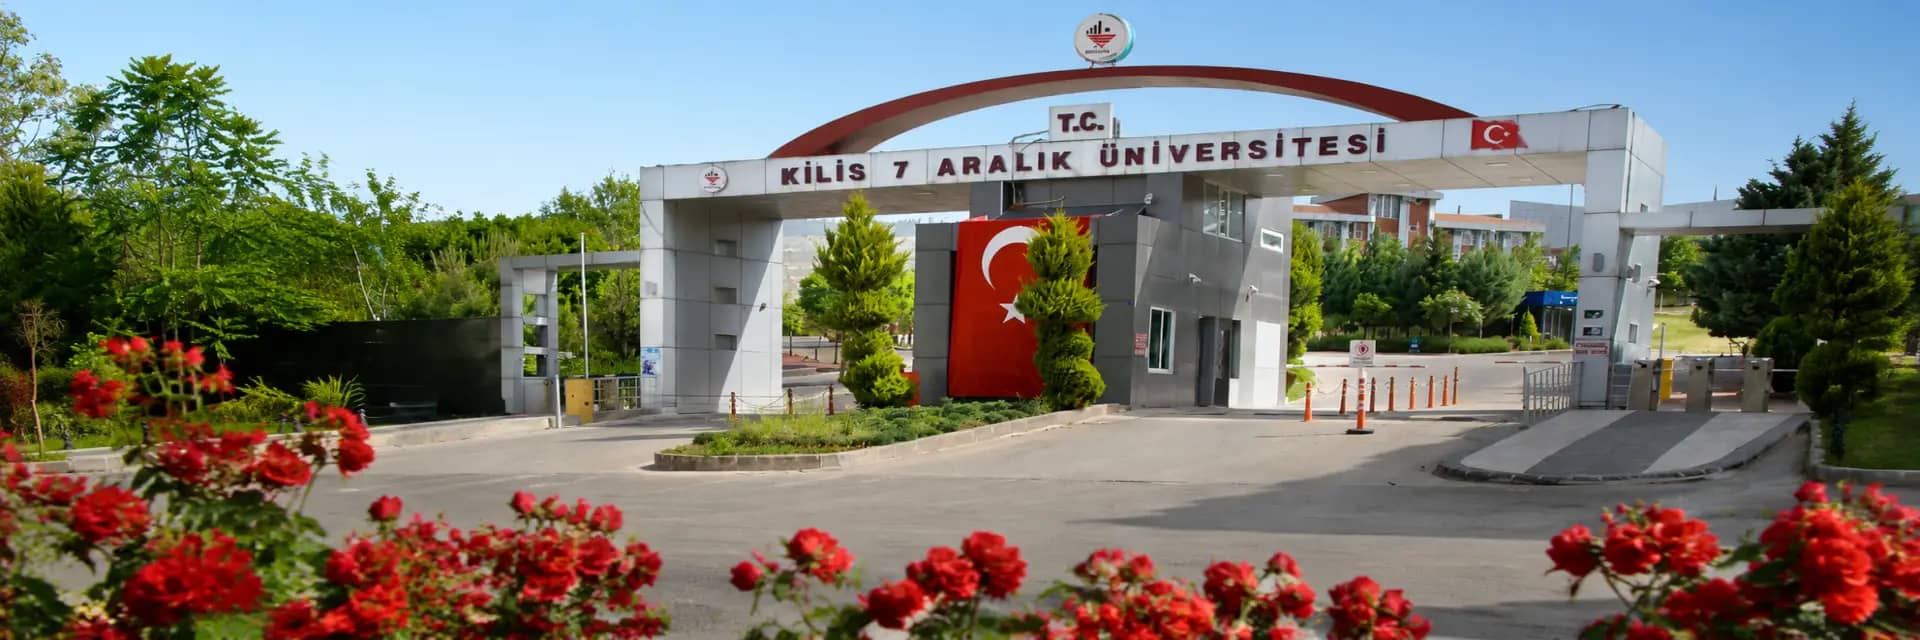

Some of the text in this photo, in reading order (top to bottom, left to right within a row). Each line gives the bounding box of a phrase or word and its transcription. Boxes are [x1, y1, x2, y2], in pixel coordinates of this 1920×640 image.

[1057, 111, 1104, 132] T.C.
[781, 127, 1386, 186] KİLİS 7 ARALIK ÜNİVERSİTESİ
